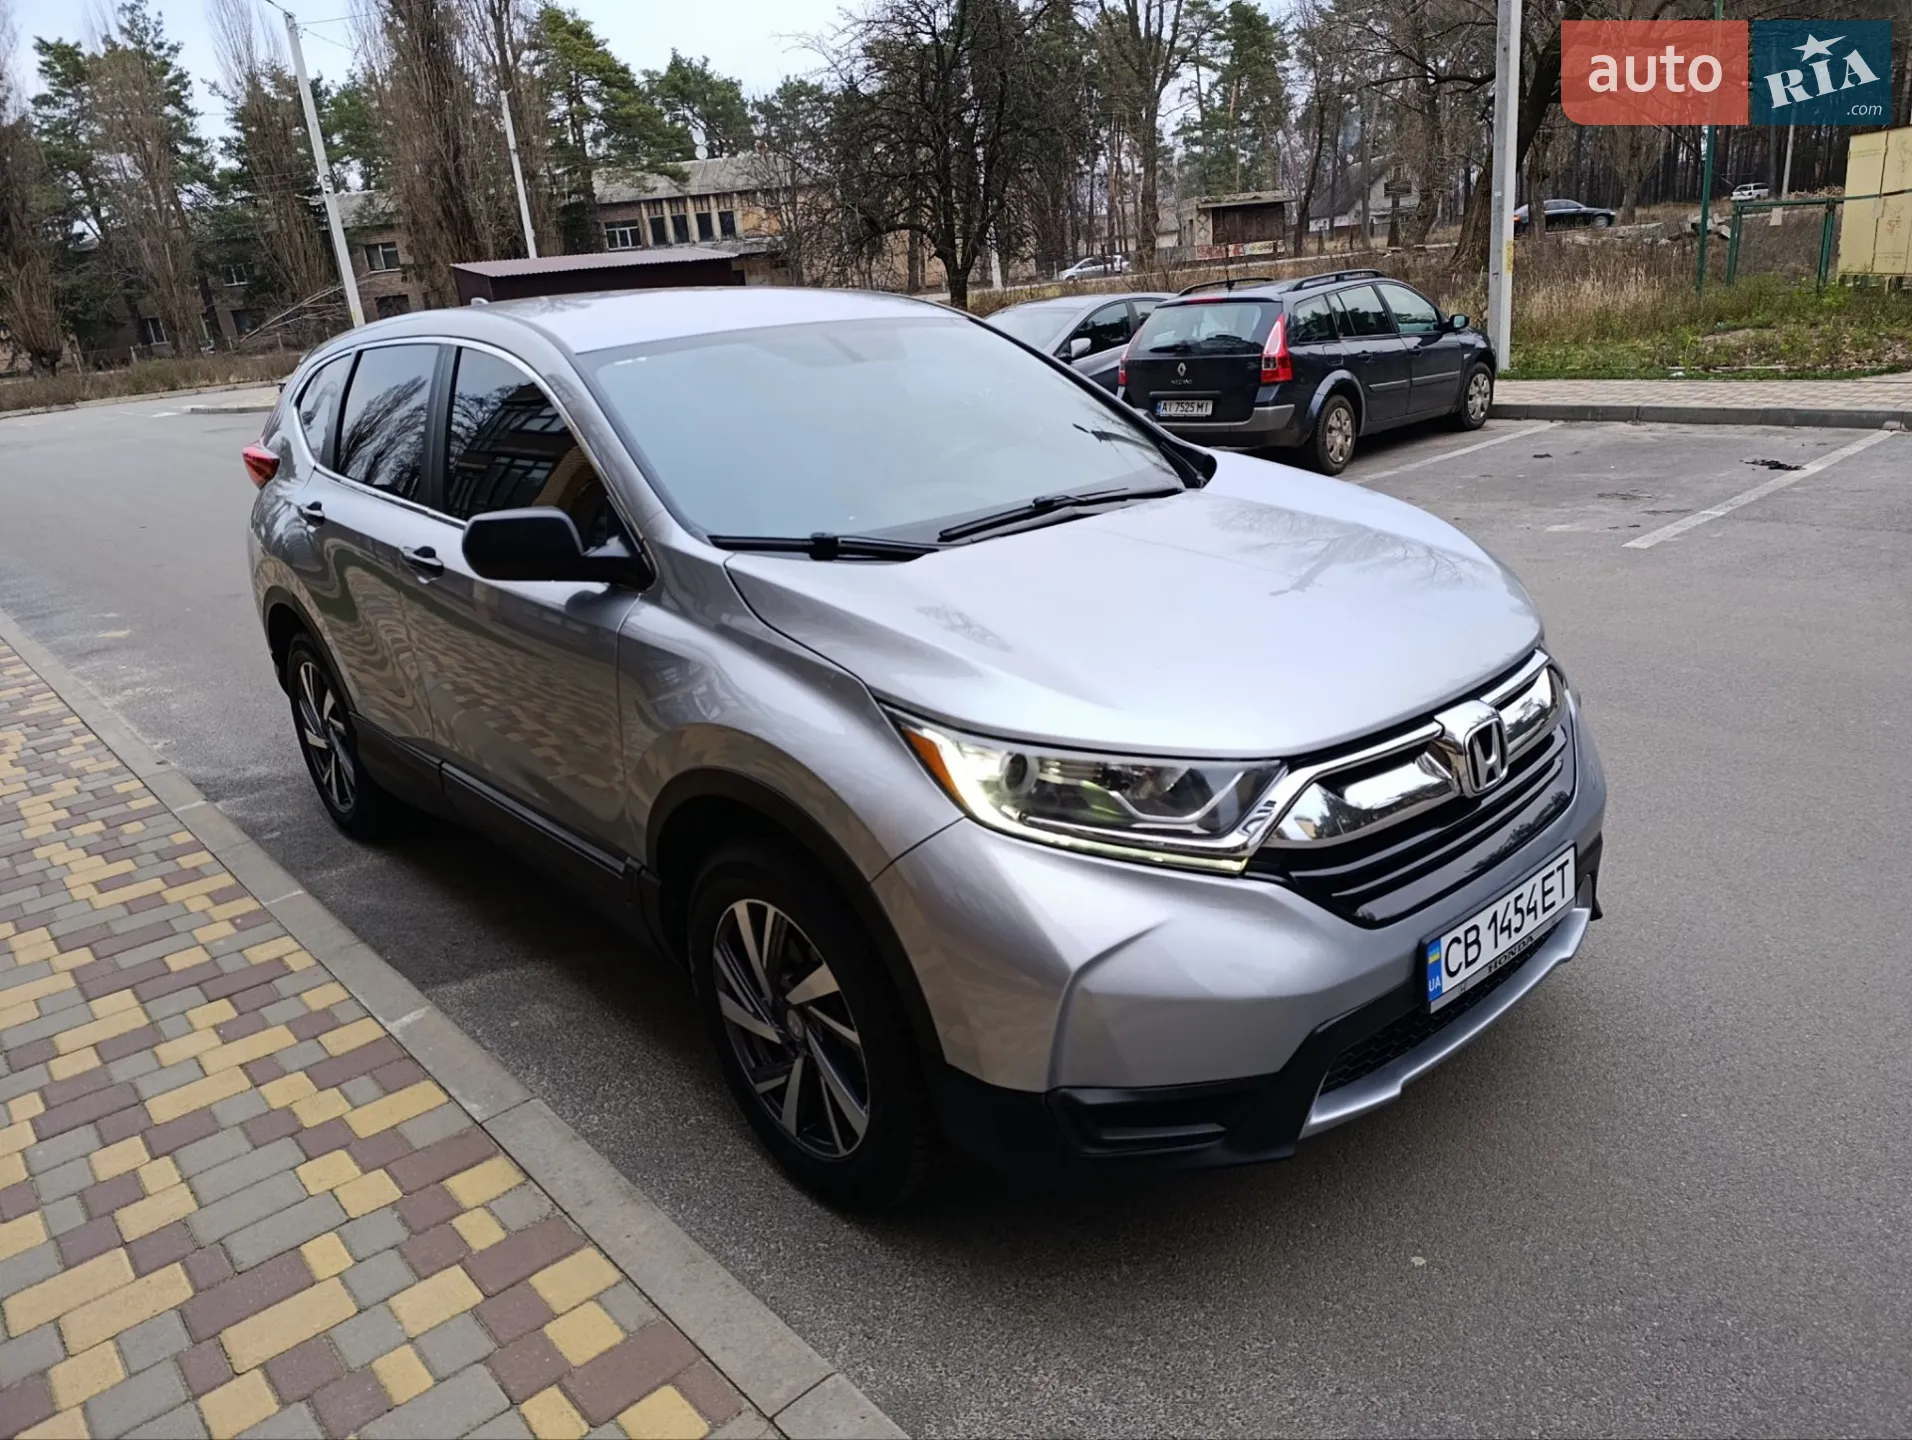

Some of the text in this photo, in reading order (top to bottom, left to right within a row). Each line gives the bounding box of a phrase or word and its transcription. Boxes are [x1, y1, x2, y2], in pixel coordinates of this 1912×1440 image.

[1175, 401, 1195, 413] 7525
[1444, 923, 1482, 978] CB
[1487, 935, 1535, 974] HONDA
[1428, 975, 1442, 992] UA
